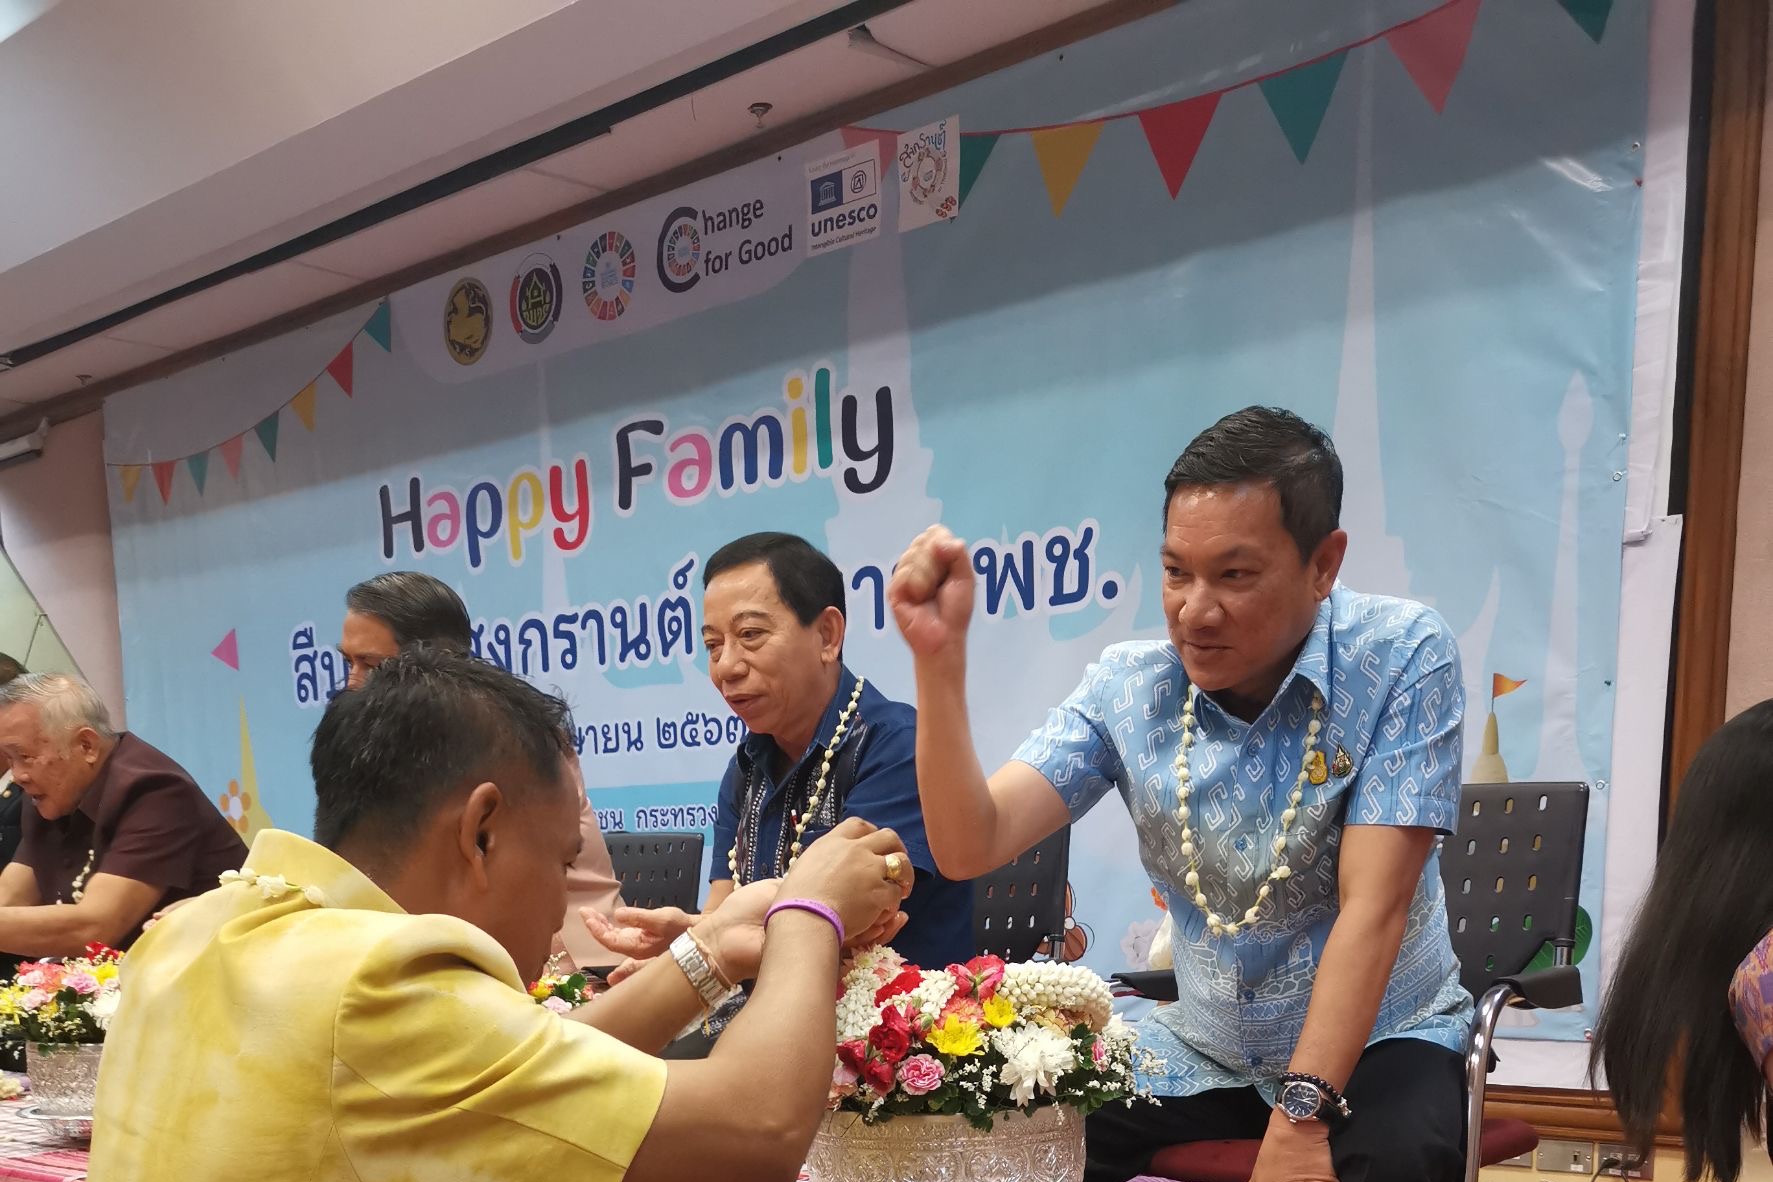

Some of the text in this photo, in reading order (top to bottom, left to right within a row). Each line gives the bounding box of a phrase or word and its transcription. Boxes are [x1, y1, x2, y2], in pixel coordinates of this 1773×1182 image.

[704, 223, 793, 276] for Good
[811, 203, 878, 237] unesco
[379, 367, 894, 569] Happy Family
[972, 526, 1119, 615] พช.
